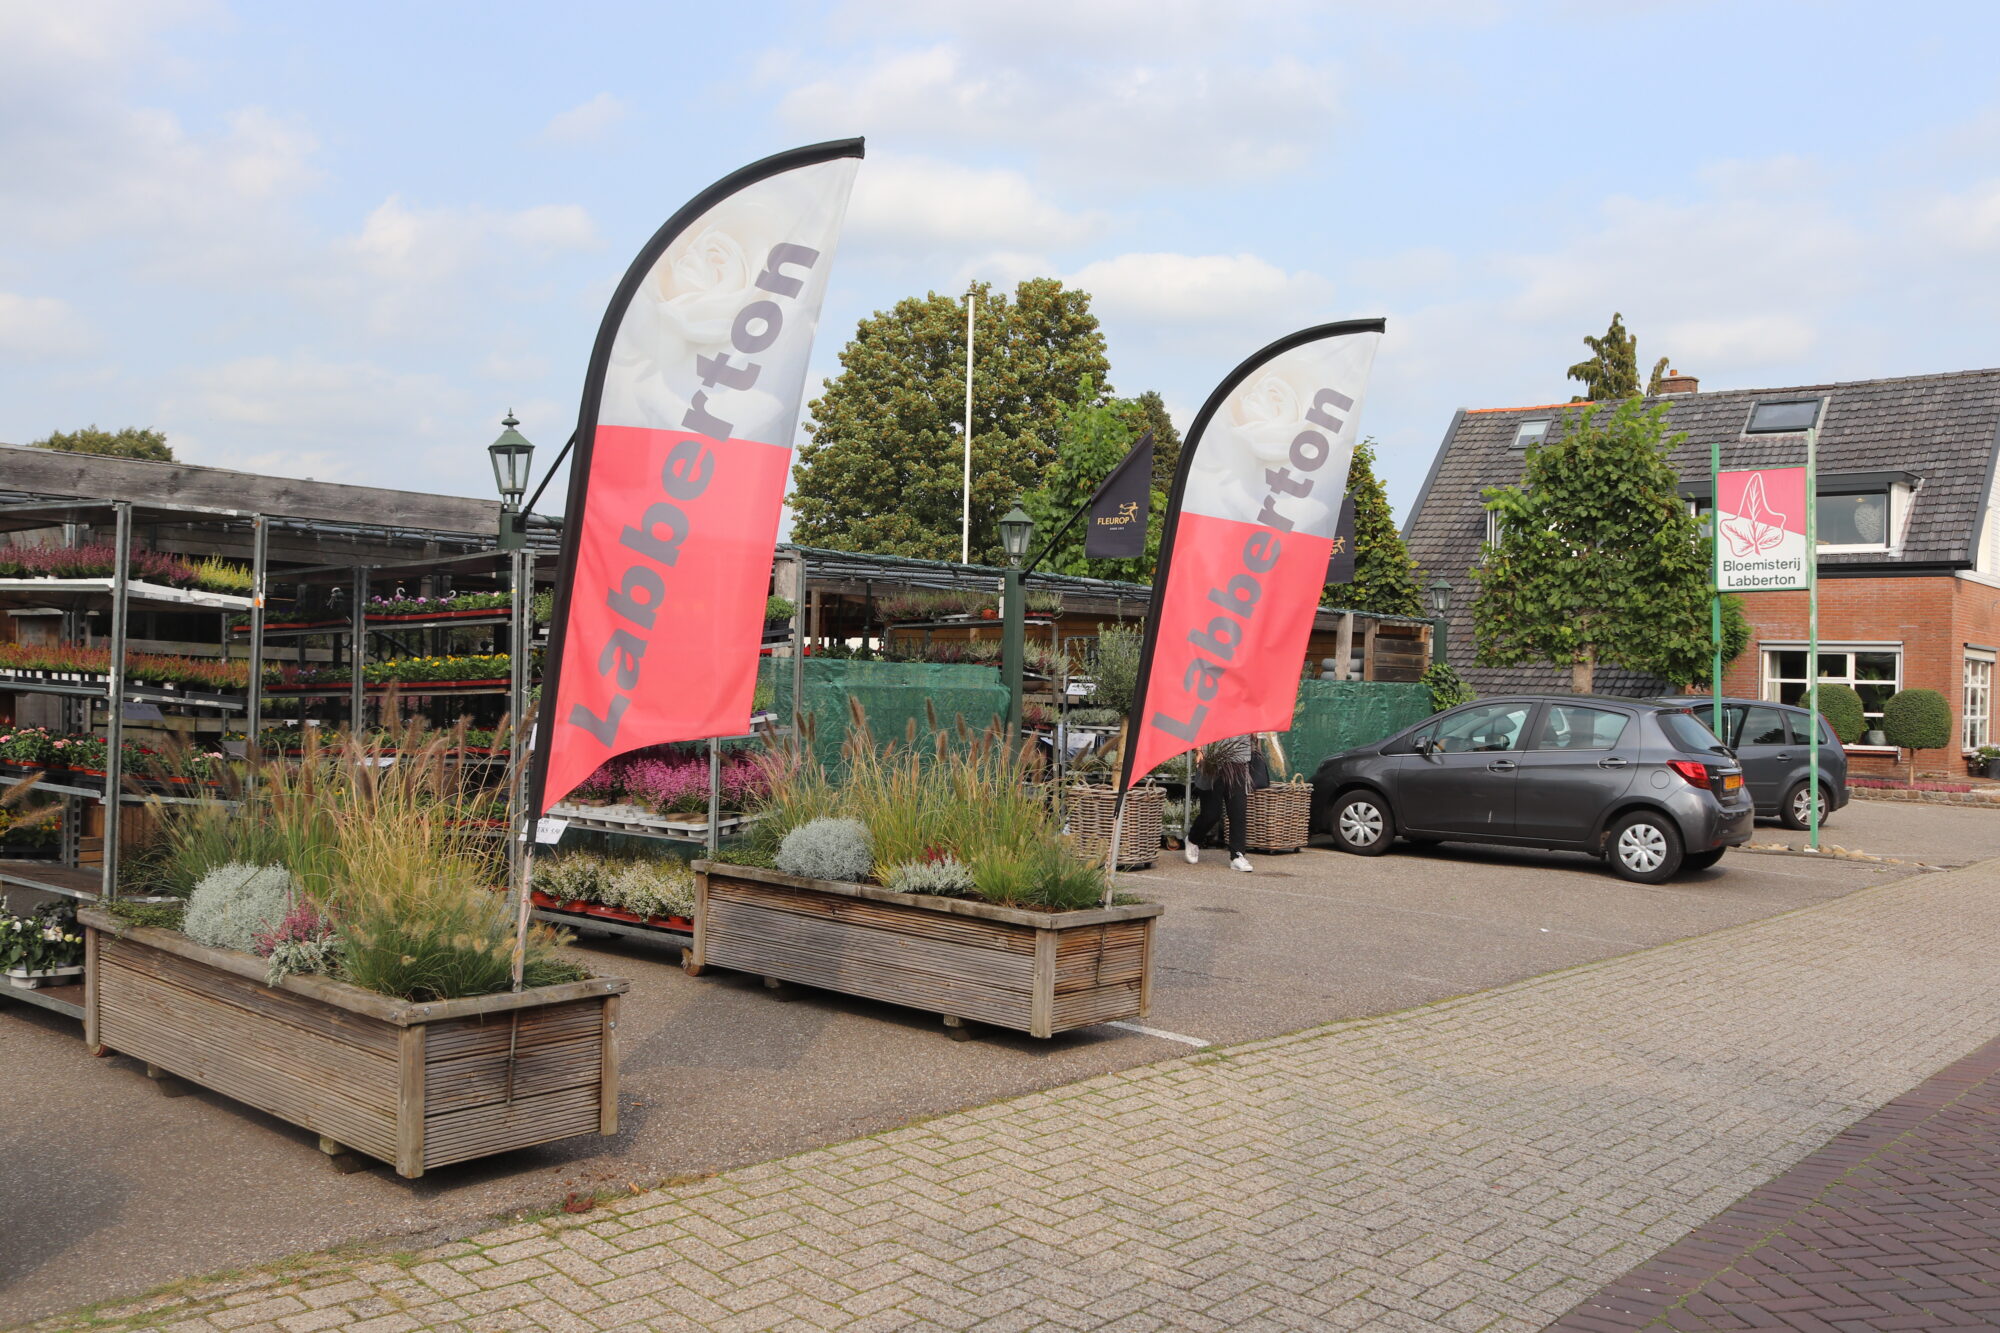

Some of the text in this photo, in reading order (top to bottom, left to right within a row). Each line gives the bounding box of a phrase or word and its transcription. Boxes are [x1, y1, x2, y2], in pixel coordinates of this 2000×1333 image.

[567, 239, 820, 748] Labberton
[1097, 516, 1130, 525] FLEUROP
[1150, 387, 1354, 742] Labberton
[1723, 557, 1801, 572] Bloemisterij
[1728, 575, 1796, 587] Labberton
